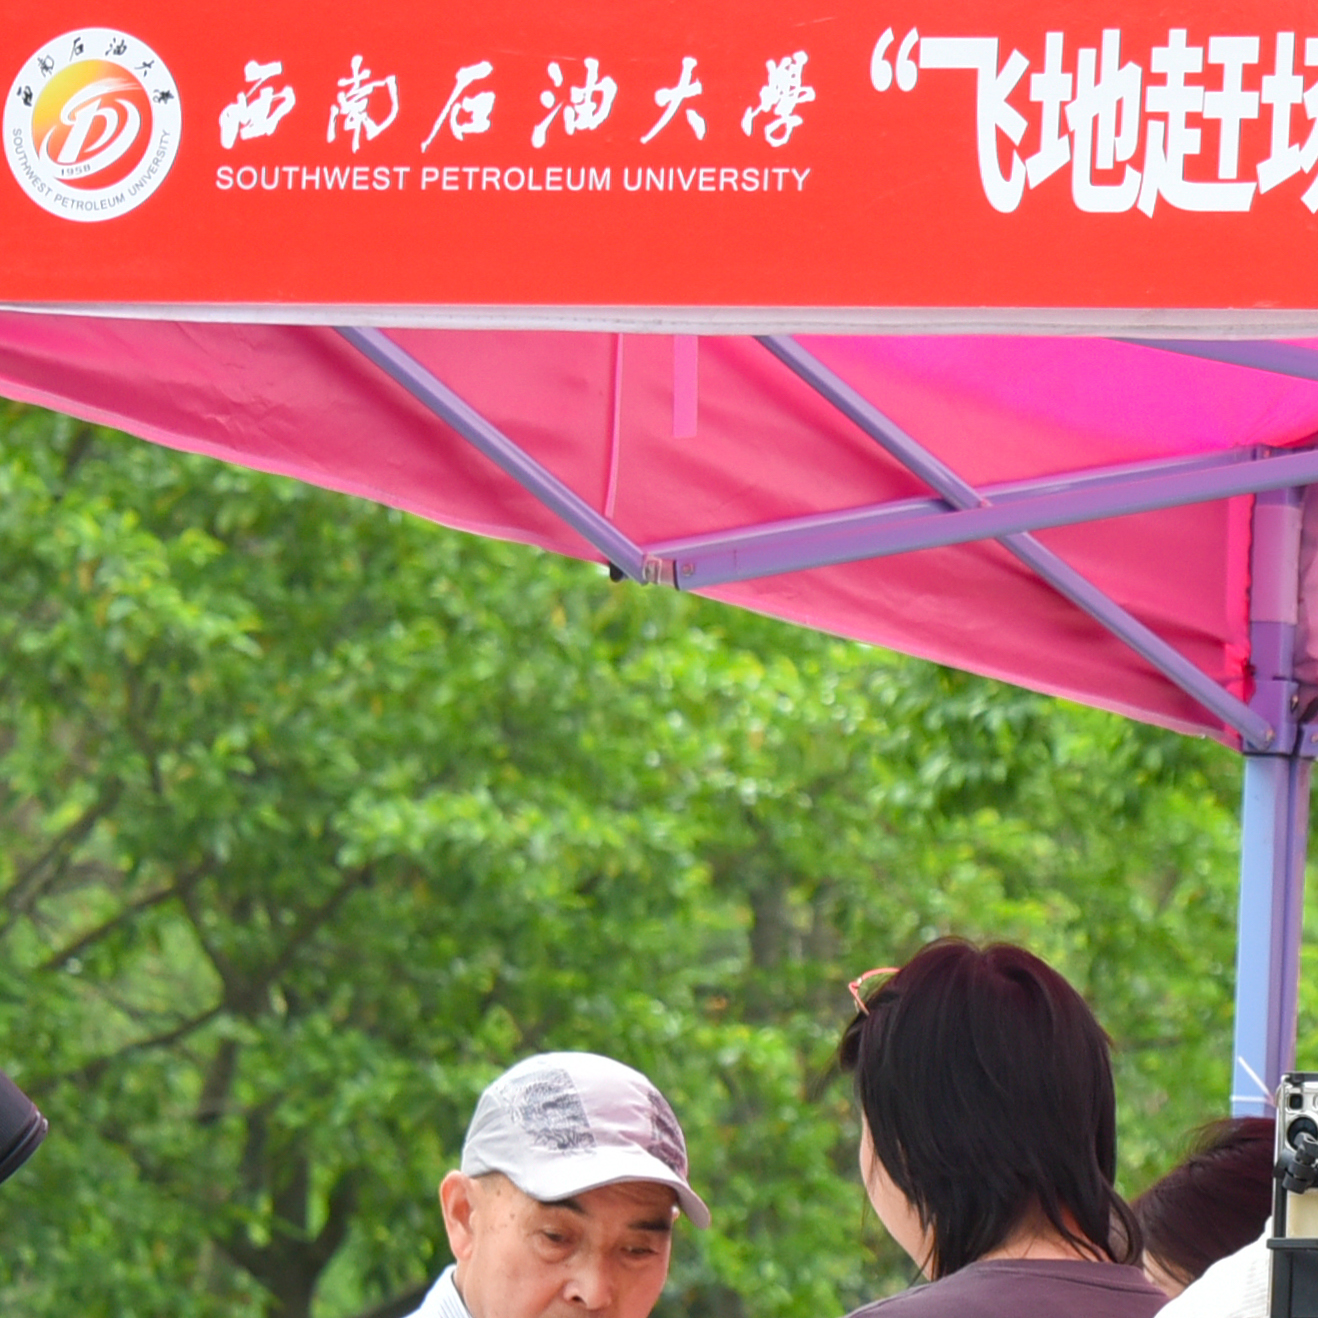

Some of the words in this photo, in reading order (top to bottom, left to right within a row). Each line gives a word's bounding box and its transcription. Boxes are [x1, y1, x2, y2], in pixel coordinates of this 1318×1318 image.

[12, 127, 53, 198] SOUTHWEST
[53, 192, 126, 212] PETROLEUM
[128, 129, 171, 197] UNIVERSITY
[216, 166, 411, 191] SOUTHWEST
[421, 167, 612, 191] PETROLEUM
[623, 167, 811, 192] UNIVERSITY
